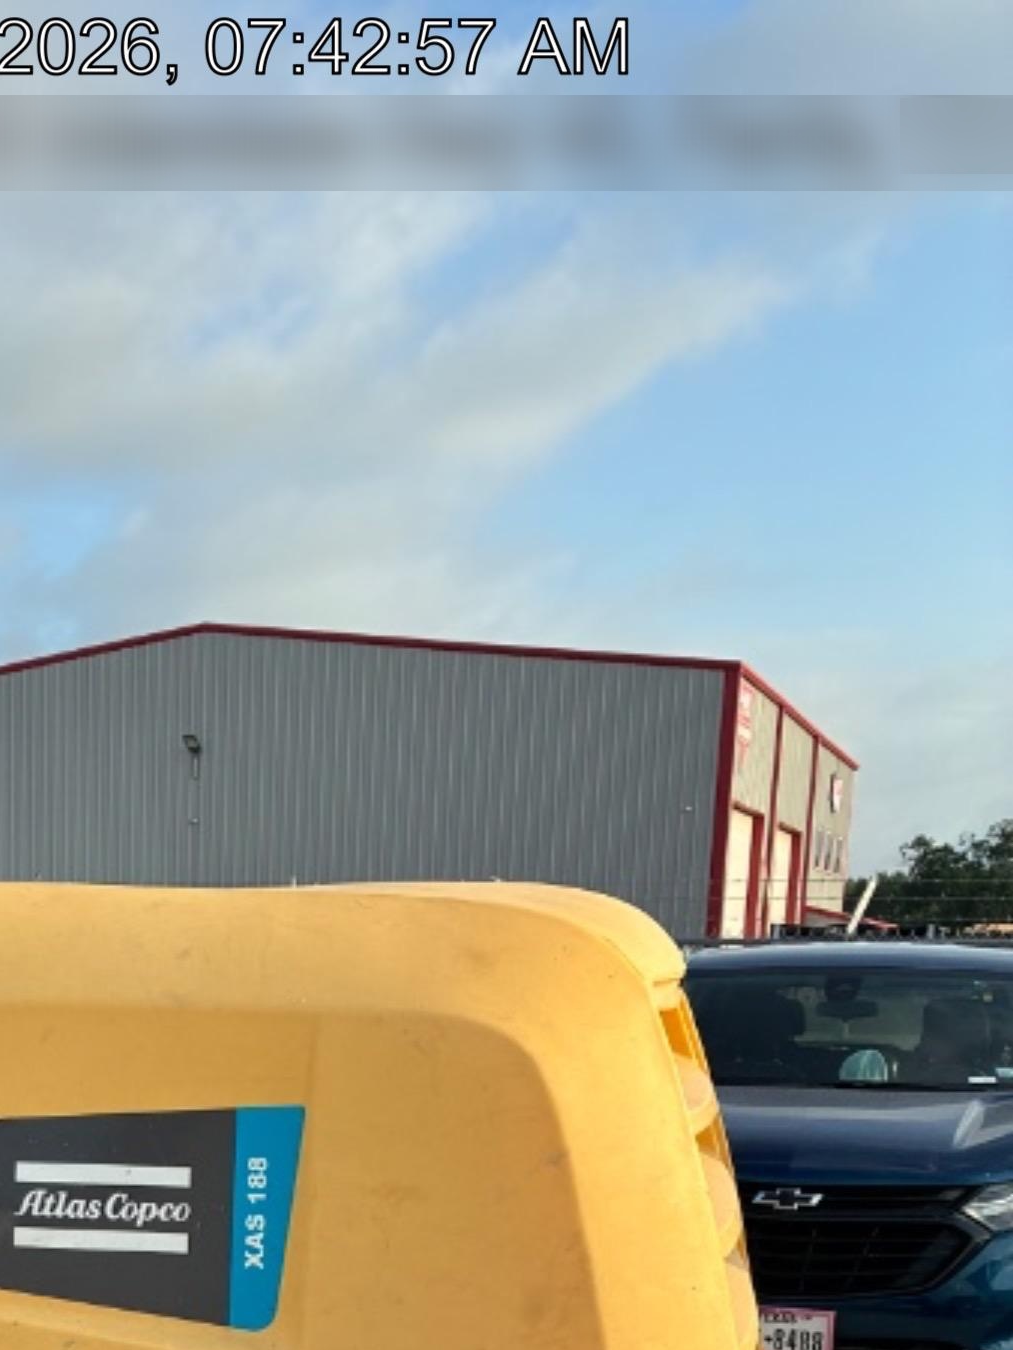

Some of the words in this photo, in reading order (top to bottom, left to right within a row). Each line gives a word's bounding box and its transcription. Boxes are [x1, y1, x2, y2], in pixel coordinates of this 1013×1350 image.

[247, 1157, 268, 1204] 188
[13, 1188, 102, 1220] Atlas
[104, 1192, 191, 1228] Copco
[244, 1213, 266, 1270] XAS
